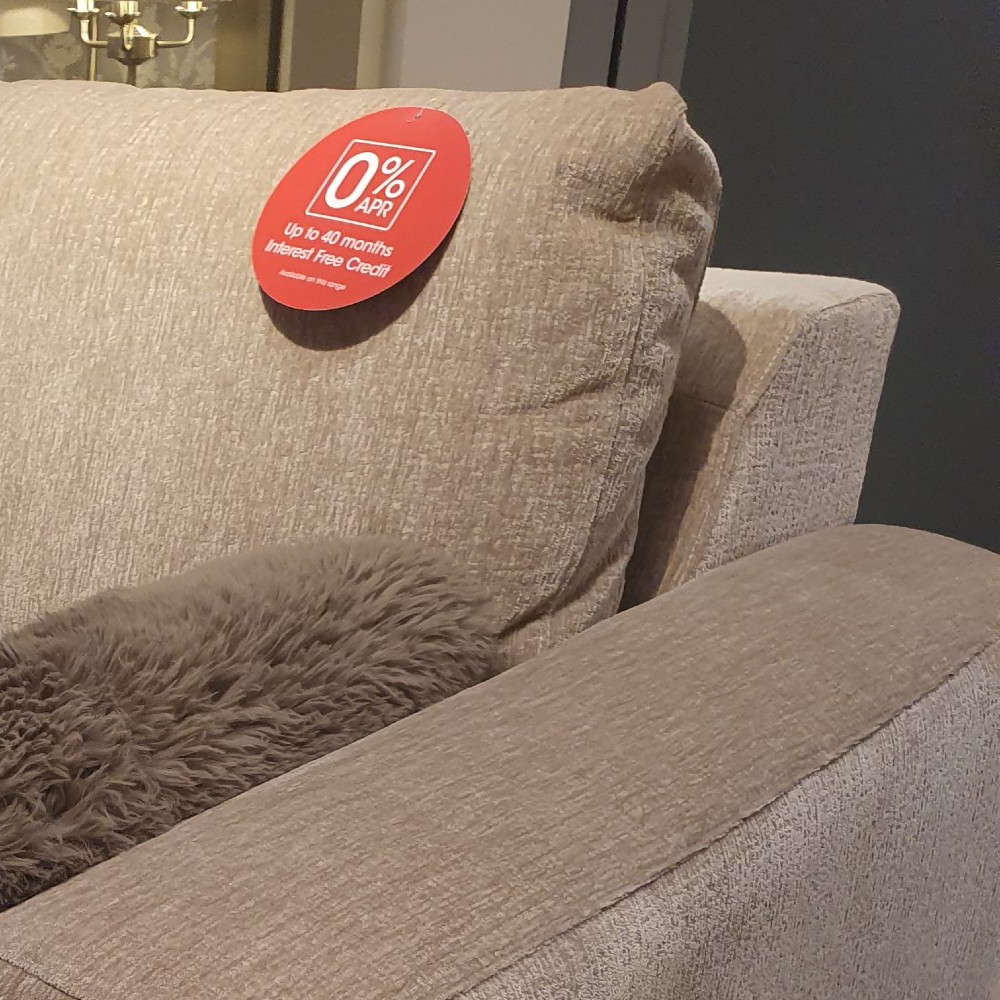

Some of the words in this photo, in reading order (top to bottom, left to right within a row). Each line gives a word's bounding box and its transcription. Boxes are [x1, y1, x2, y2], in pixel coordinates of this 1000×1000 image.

[325, 151, 415, 209] 0%
[354, 197, 394, 219] APR
[283, 222, 304, 239] Up
[304, 226, 320, 241] to
[321, 230, 341, 245] 40
[340, 236, 394, 257] months
[264, 239, 315, 260] Interest
[313, 249, 344, 267] Free
[346, 256, 392, 278] Credit
